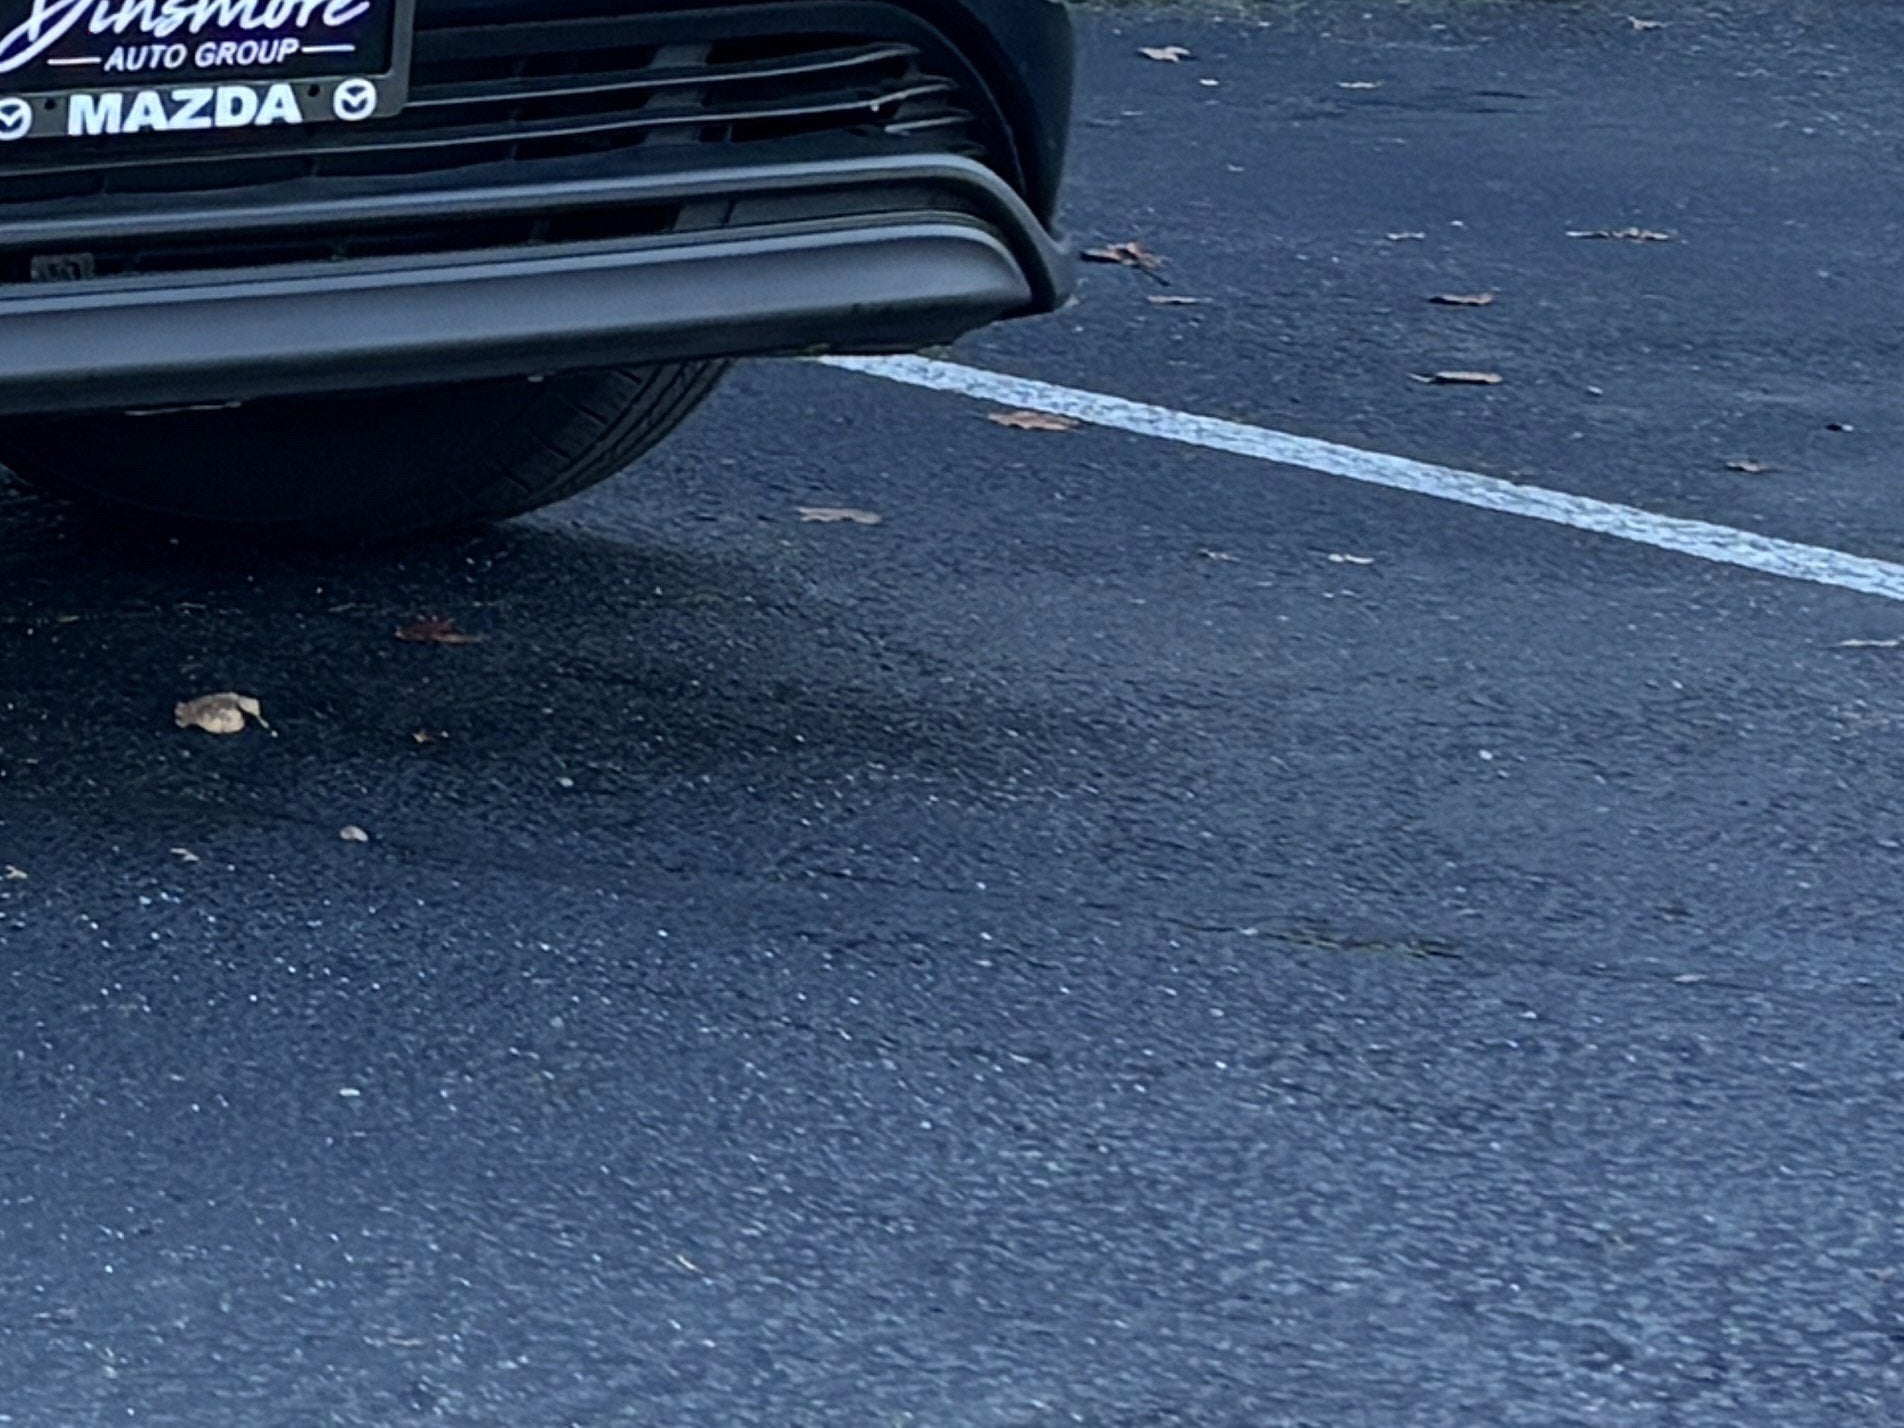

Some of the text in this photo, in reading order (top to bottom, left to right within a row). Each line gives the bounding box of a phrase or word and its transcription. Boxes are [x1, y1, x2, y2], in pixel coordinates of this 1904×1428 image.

[104, 38, 300, 72] AUTO GROUP
[67, 82, 304, 137] MAZDA
